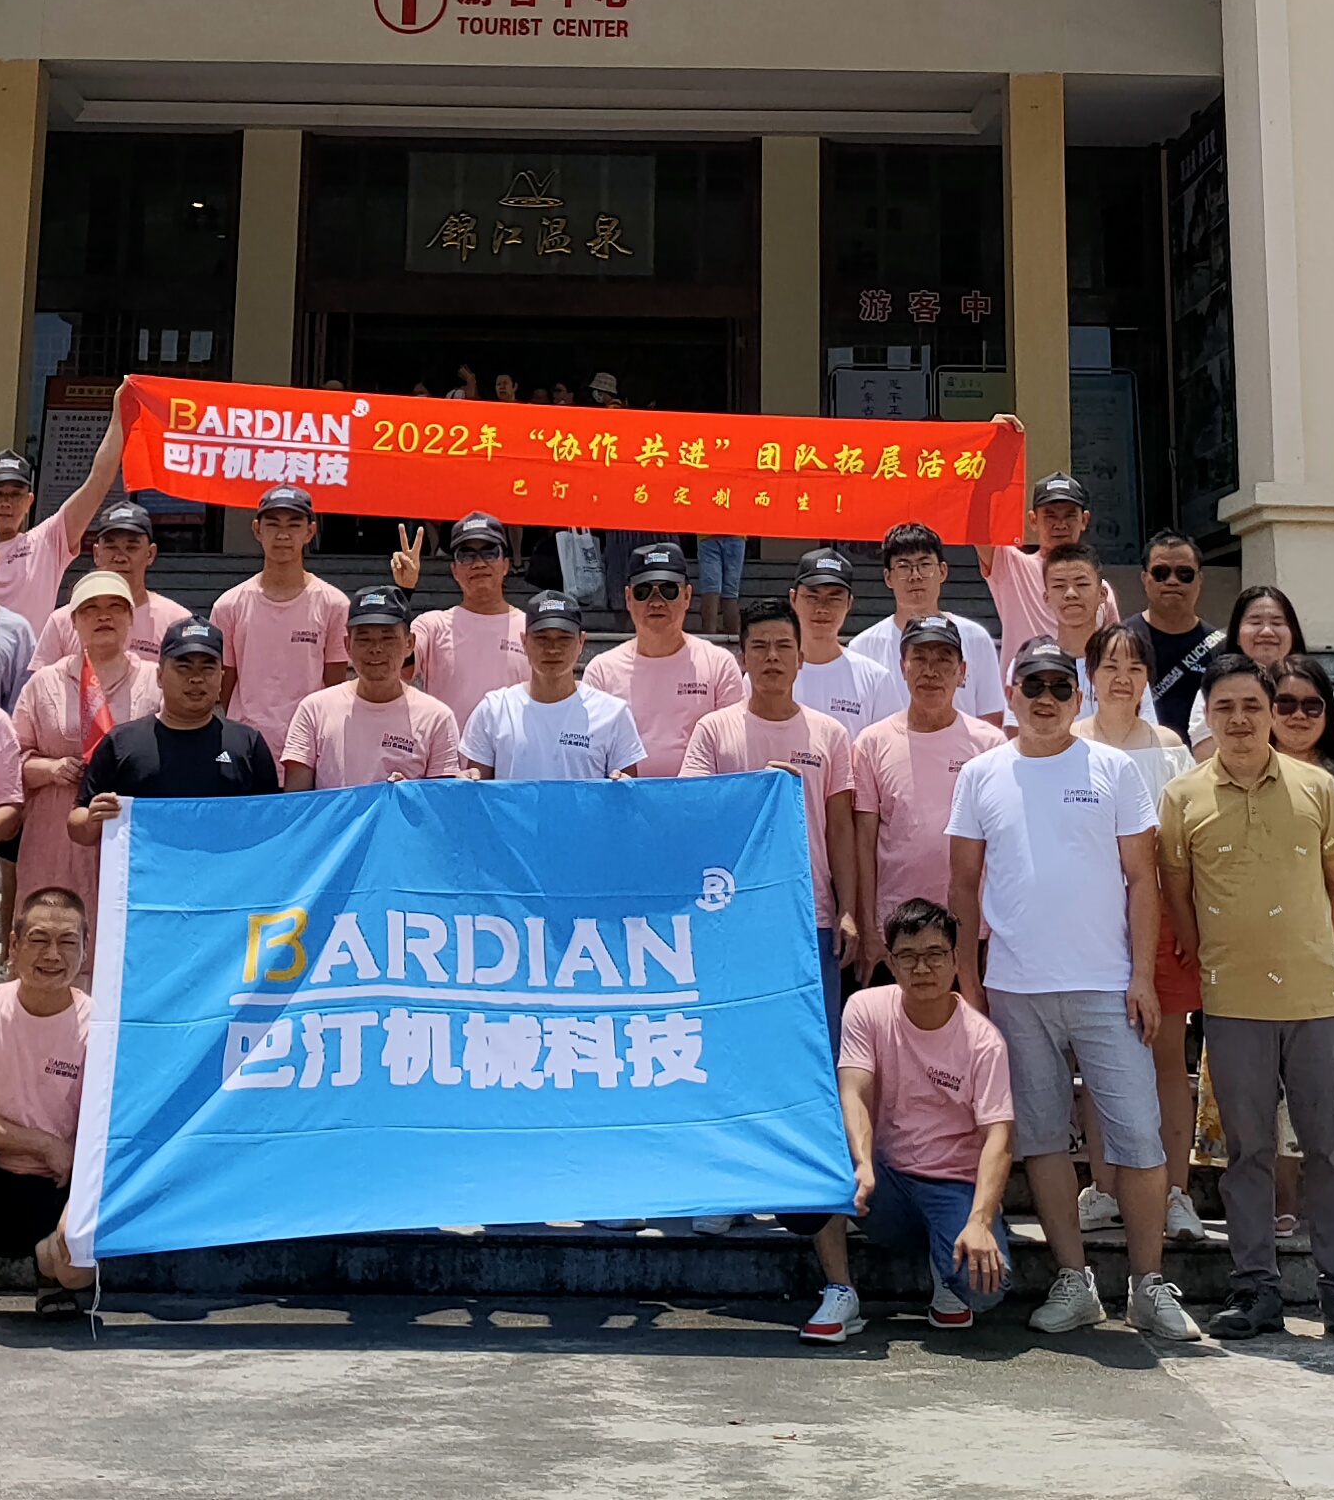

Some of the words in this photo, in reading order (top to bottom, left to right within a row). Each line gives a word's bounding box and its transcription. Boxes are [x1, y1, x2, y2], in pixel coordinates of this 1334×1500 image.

[457, 16, 543, 37] TOURIST
[553, 18, 629, 38] CENTER
[169, 398, 350, 445] BARDIAN
[163, 443, 349, 487] 巴汀机械科技
[242, 907, 696, 988] BARDIAN
[222, 1008, 709, 1092] 巴汀机械科技
